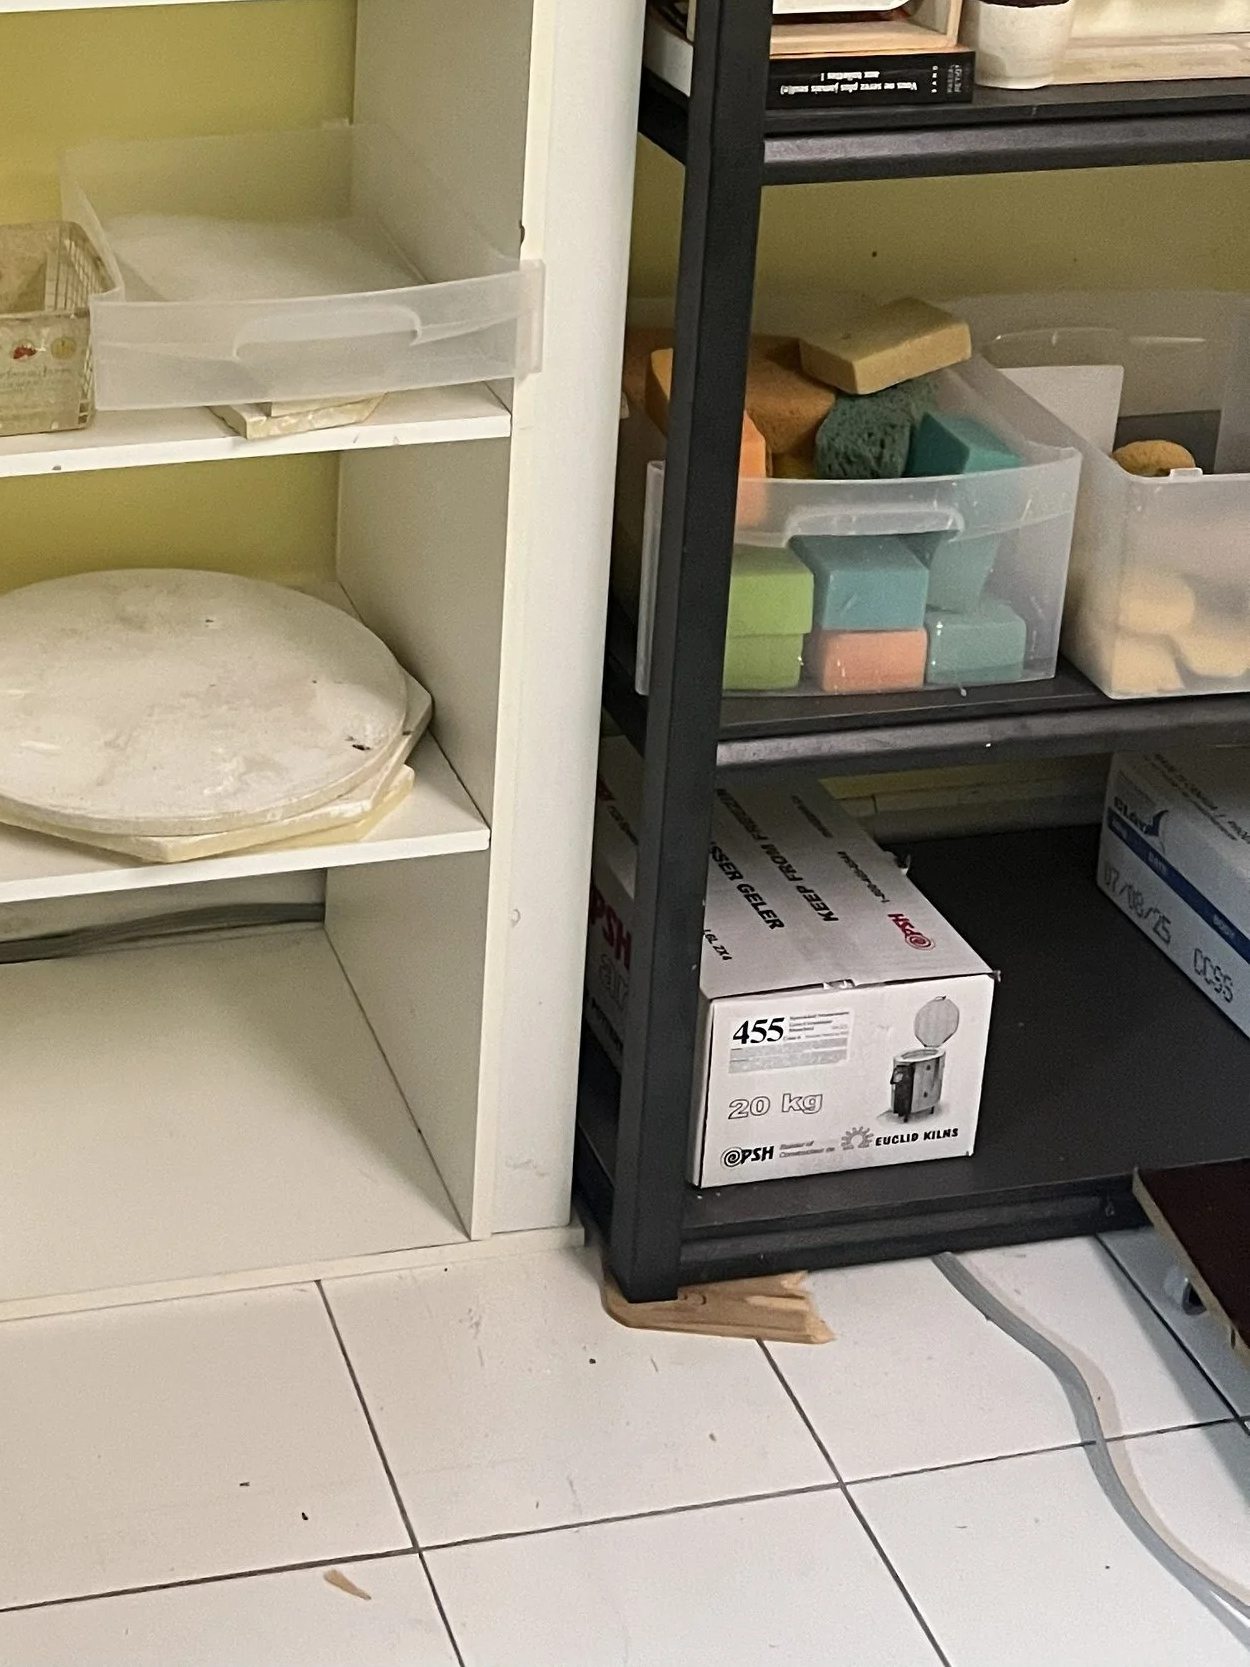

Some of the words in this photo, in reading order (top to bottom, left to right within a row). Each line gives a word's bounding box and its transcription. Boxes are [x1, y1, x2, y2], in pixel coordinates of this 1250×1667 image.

[761, 843, 803, 882] FROM
[736, 882, 785, 930] GELER
[796, 885, 839, 922] KEEP
[732, 1016, 786, 1045] 455
[727, 1095, 771, 1120] 20
[781, 1092, 824, 1115] kg
[875, 1132, 919, 1147] EUCLID
[922, 1127, 959, 1141] KILNS
[740, 1145, 775, 1165] PSH
